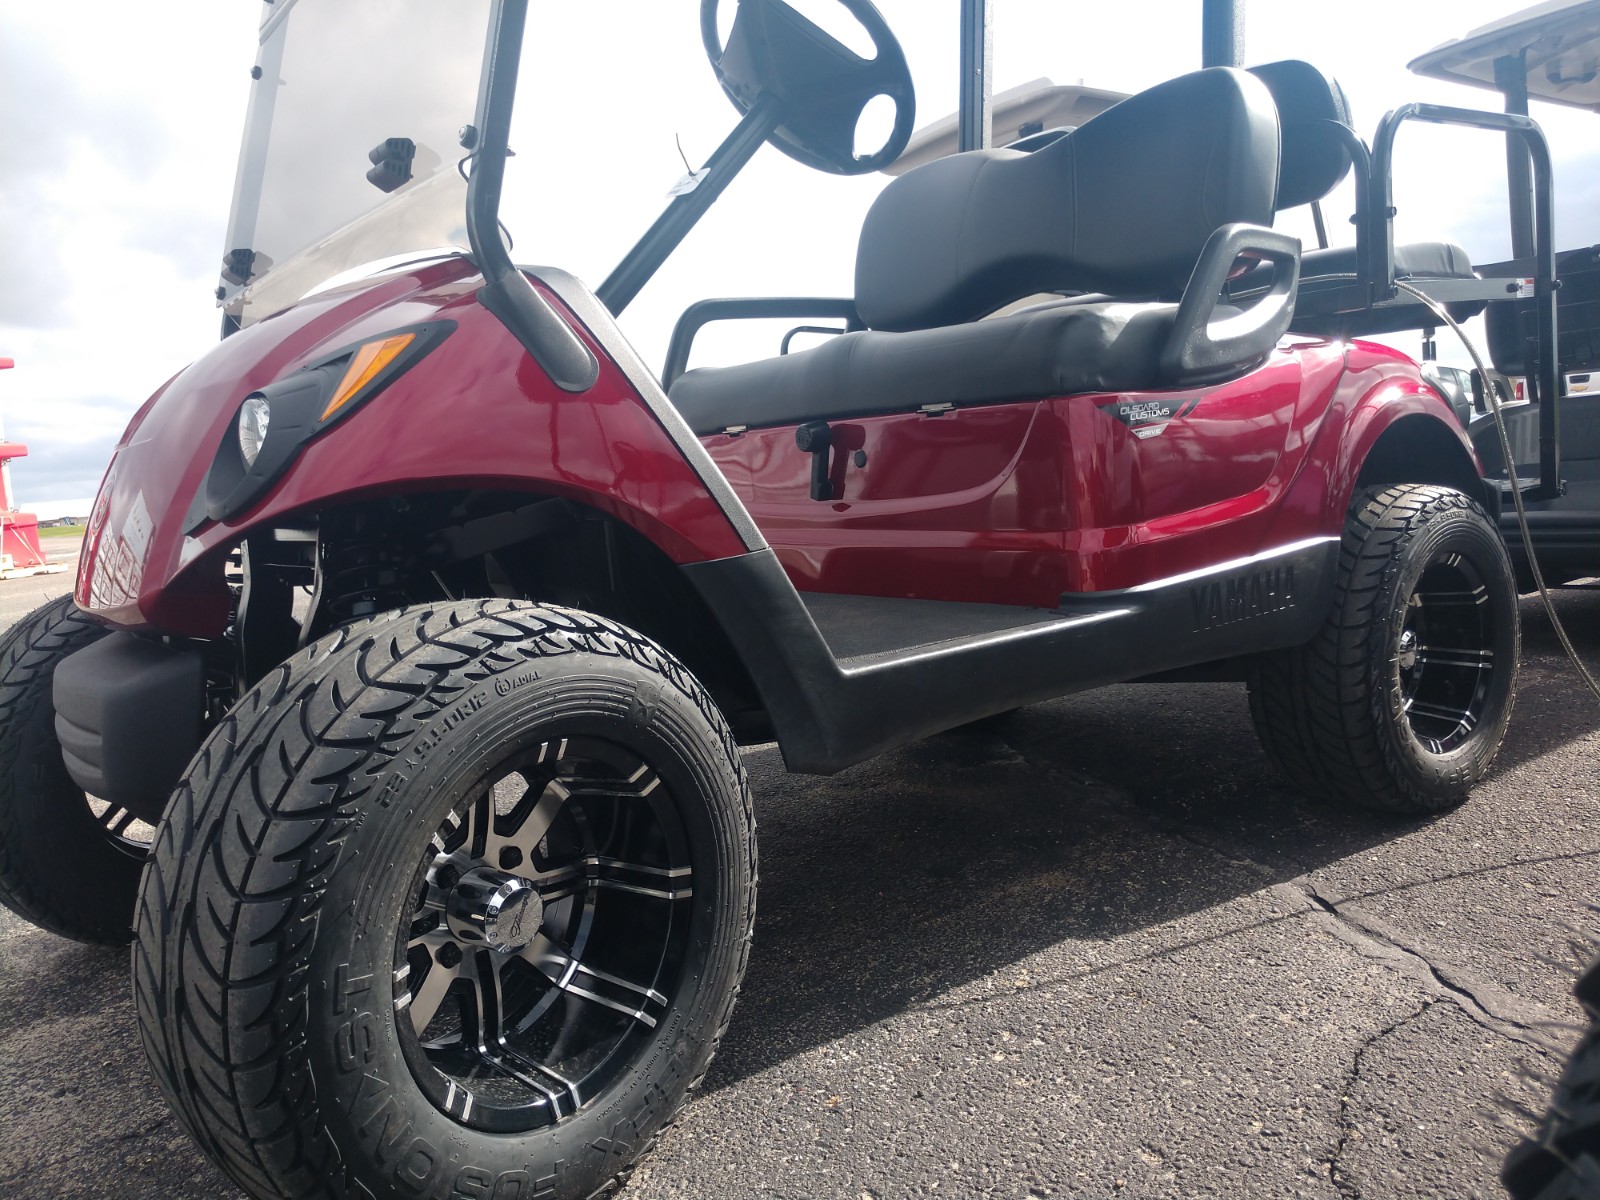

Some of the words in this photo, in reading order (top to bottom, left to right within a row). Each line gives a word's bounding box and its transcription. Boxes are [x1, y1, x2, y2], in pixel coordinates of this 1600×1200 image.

[1120, 402, 1160, 416] OLSGARD
[1129, 407, 1170, 421] CUSTOMS
[1138, 428, 1162, 438] DRIVE
[1188, 565, 1296, 633] YAMAHA
